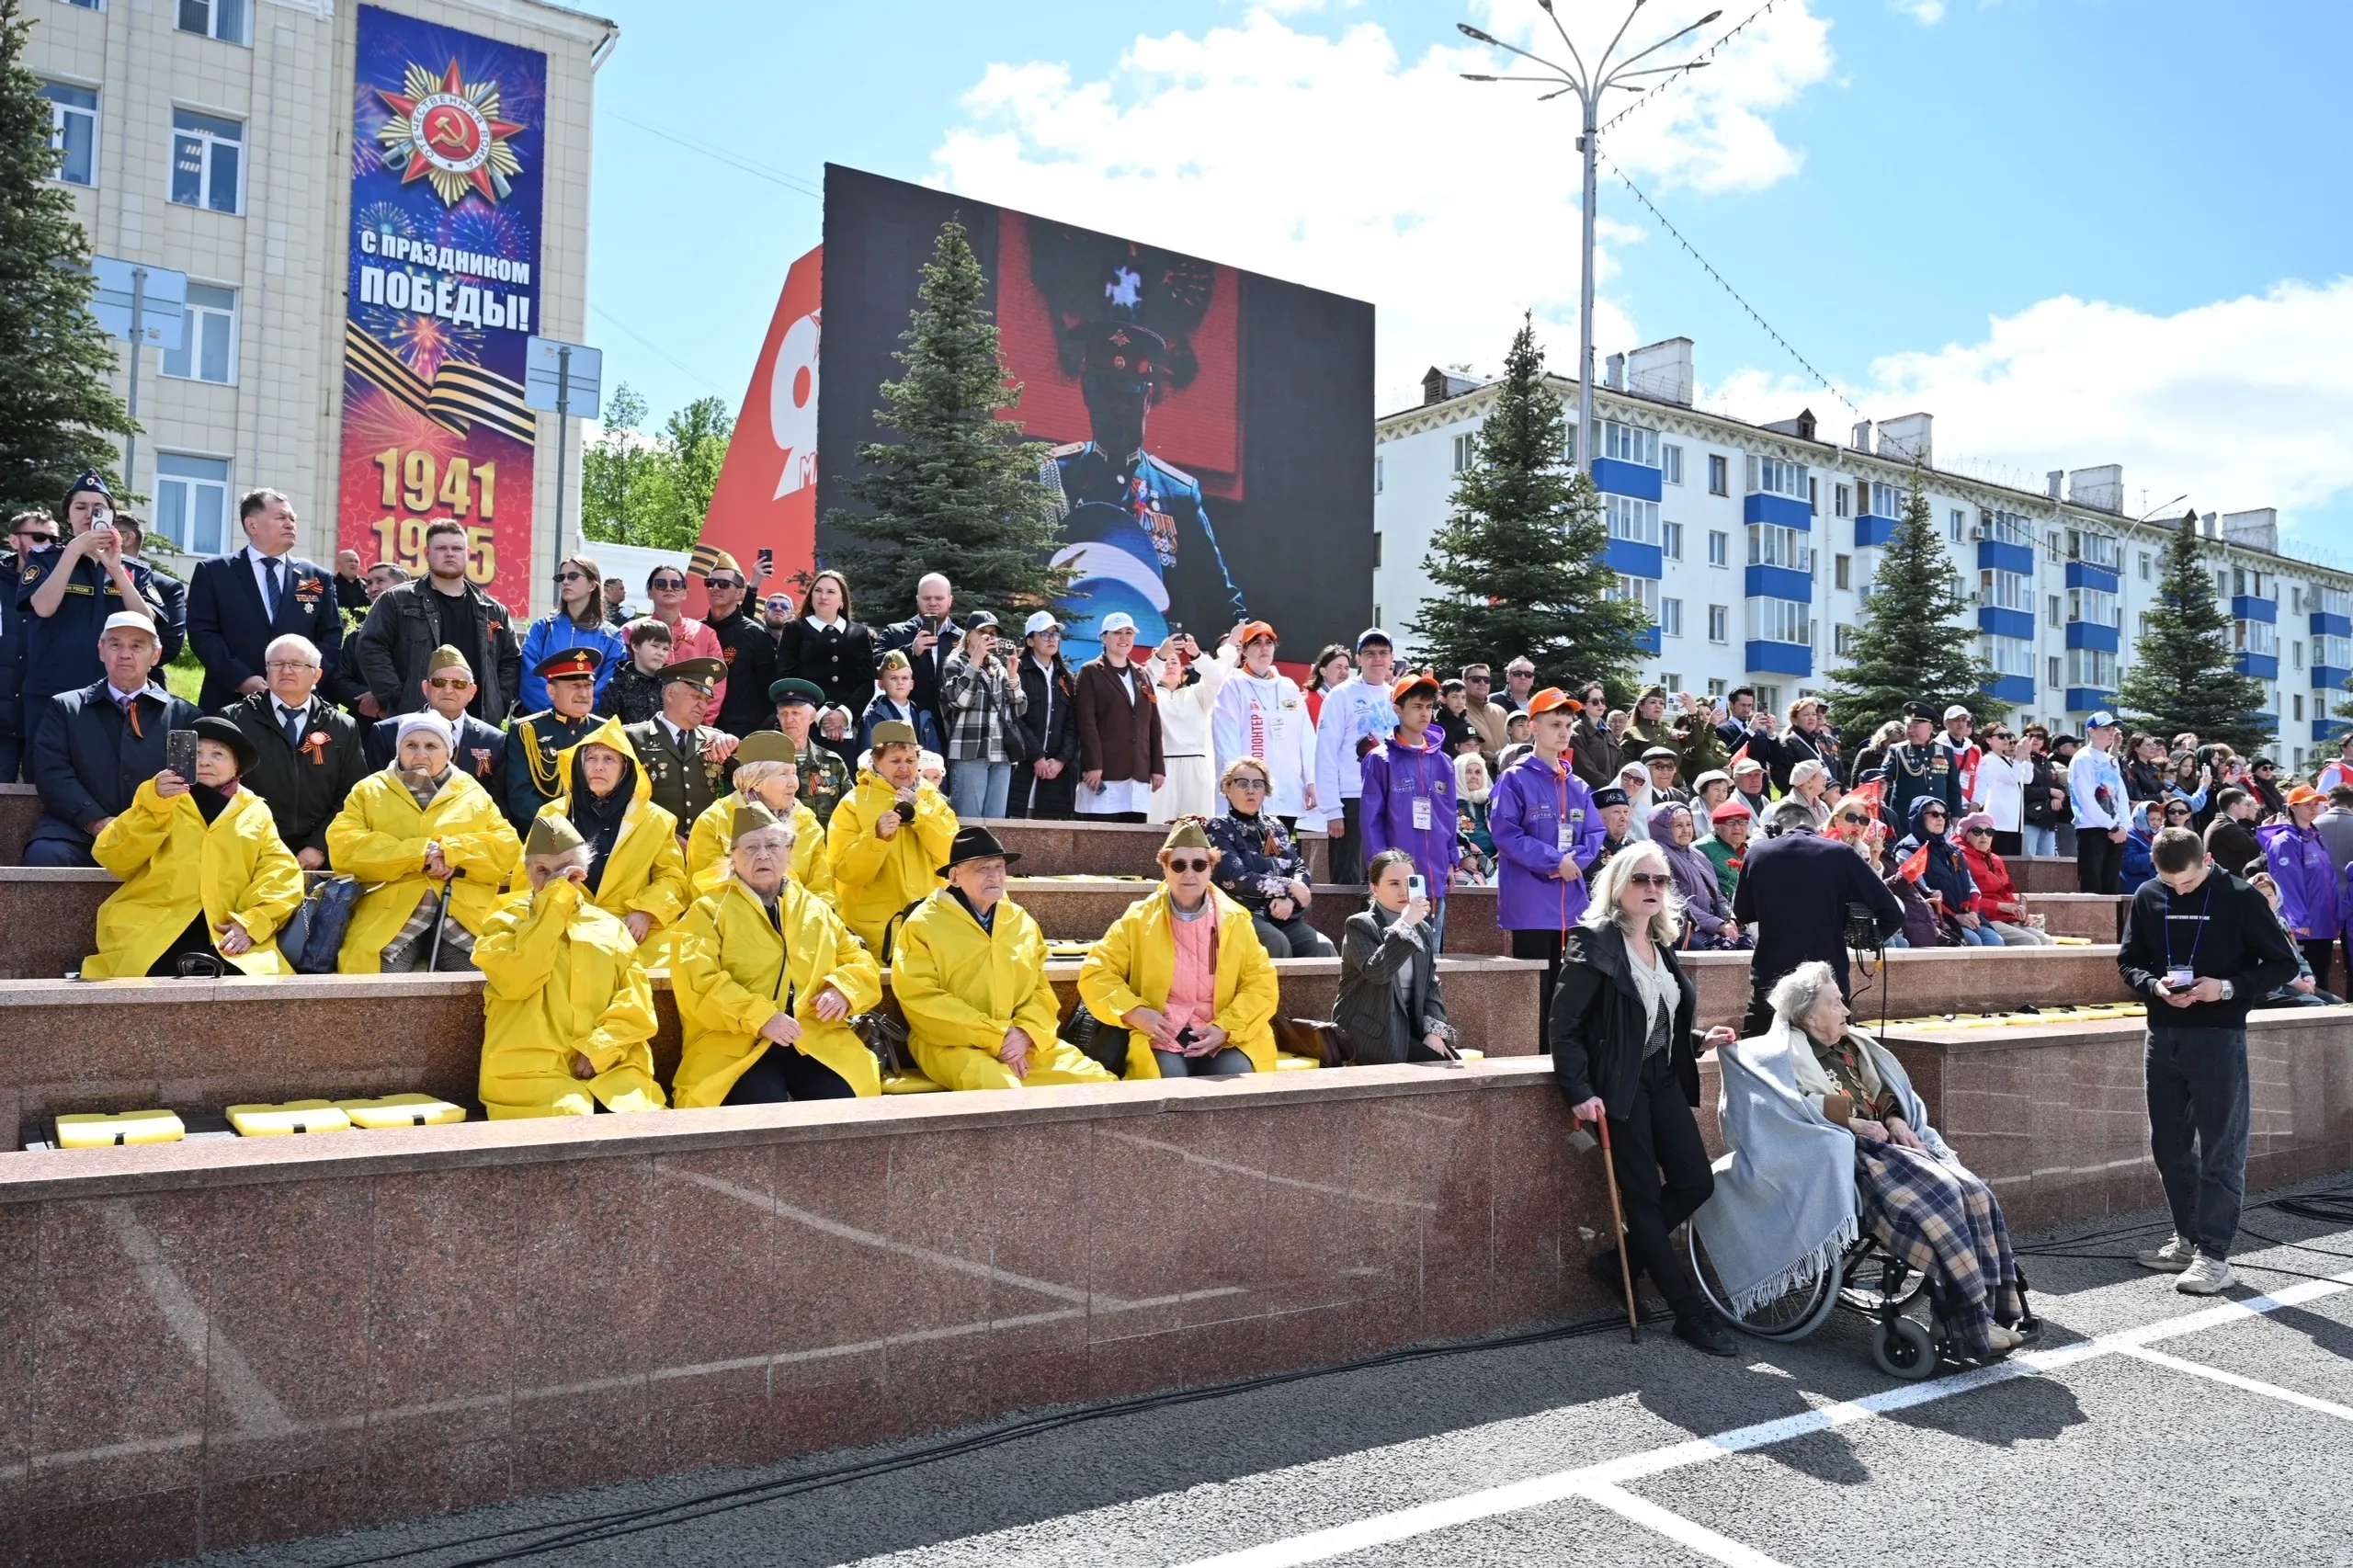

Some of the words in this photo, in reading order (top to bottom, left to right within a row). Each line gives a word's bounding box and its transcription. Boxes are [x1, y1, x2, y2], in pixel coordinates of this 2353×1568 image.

[413, 96, 483, 158] ОТЕЧЕСТВЕННАЯ
[360, 231, 377, 254] С
[381, 234, 530, 285] ПРАЗДНИКОМ
[360, 266, 530, 332] ПОБЕДЫ!
[374, 448, 496, 520] 1941
[372, 517, 495, 585] 195
[1251, 714, 1264, 761] ОЛОНТЕР
